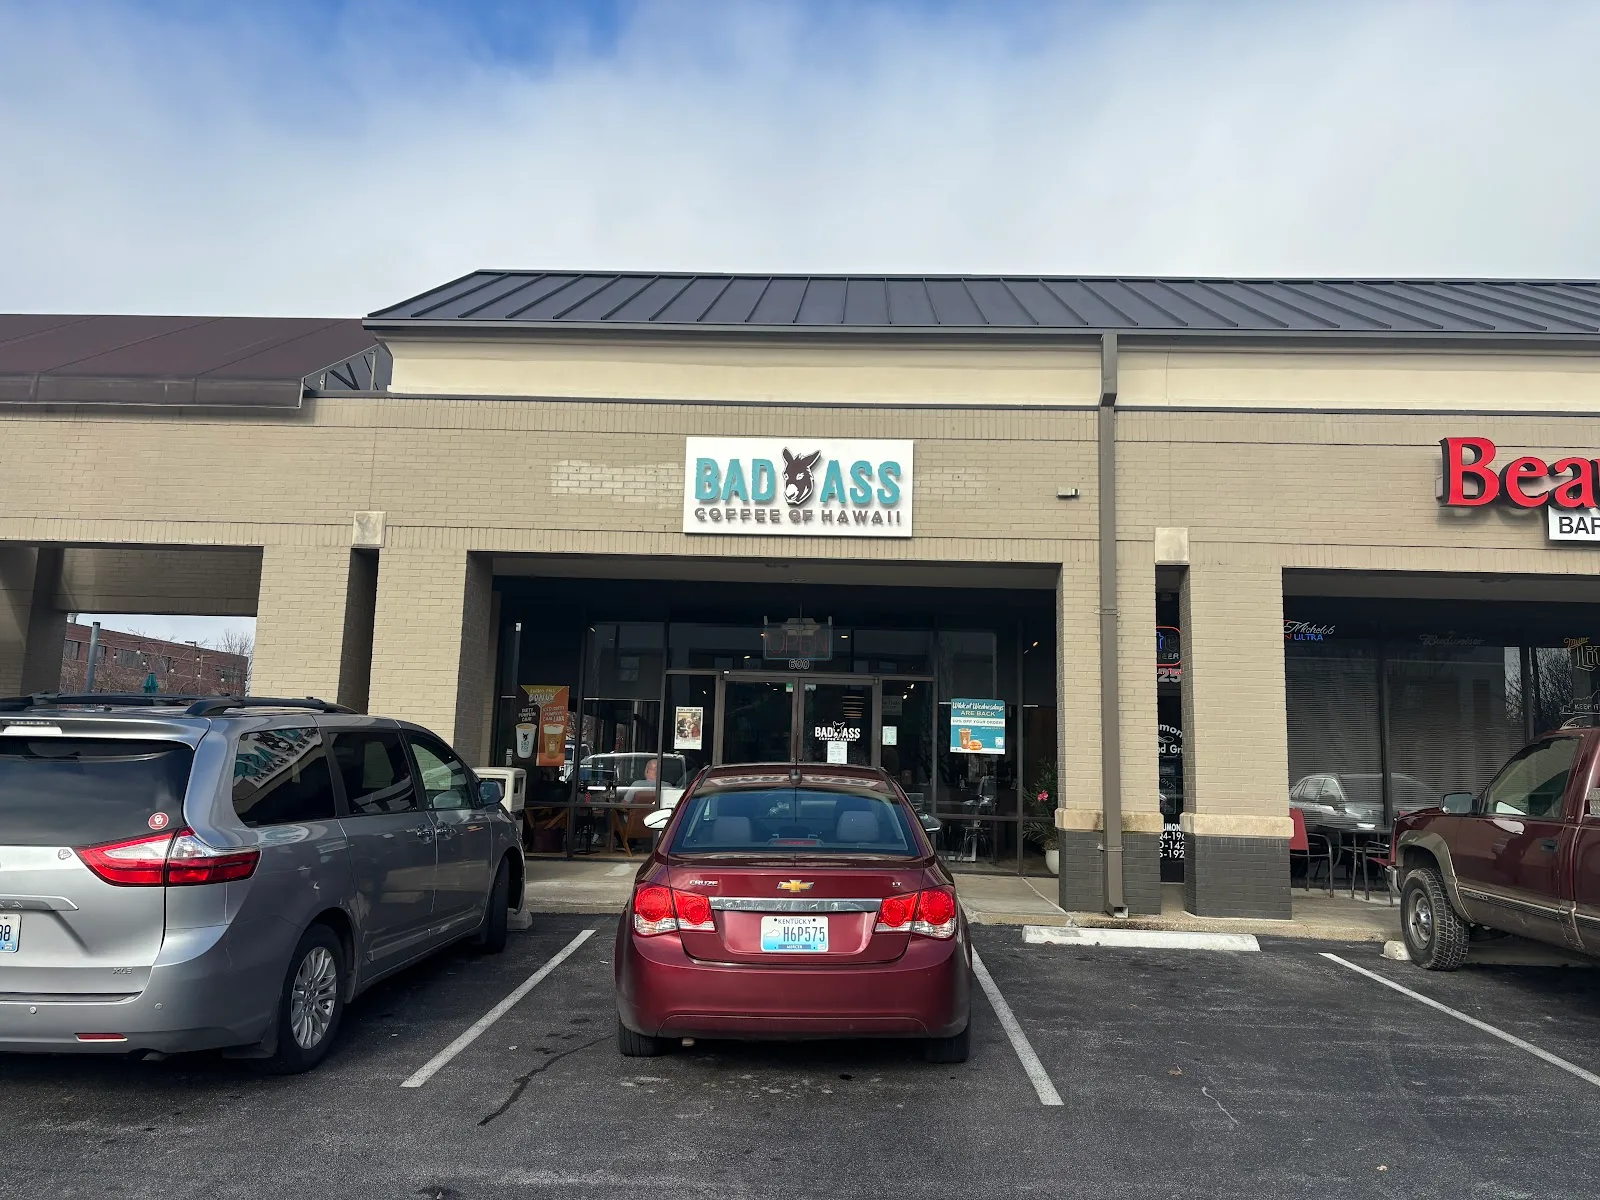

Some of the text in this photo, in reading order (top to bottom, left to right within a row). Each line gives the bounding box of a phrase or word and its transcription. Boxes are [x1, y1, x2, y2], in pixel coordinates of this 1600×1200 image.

[1440, 437, 1600, 508] Bea
[694, 457, 902, 504] BAD ASS
[694, 507, 902, 524] COFFEE OF HAWAII
[1293, 633, 1324, 641] ULTRA
[1419, 633, 1486, 646] Budweiser
[1563, 636, 1590, 650] Miller
[788, 659, 810, 669] 600
[814, 726, 861, 739] BAD ASS
[689, 879, 719, 887] CRUZE
[783, 926, 825, 942] H6P575
[112, 967, 133, 975] XLE
